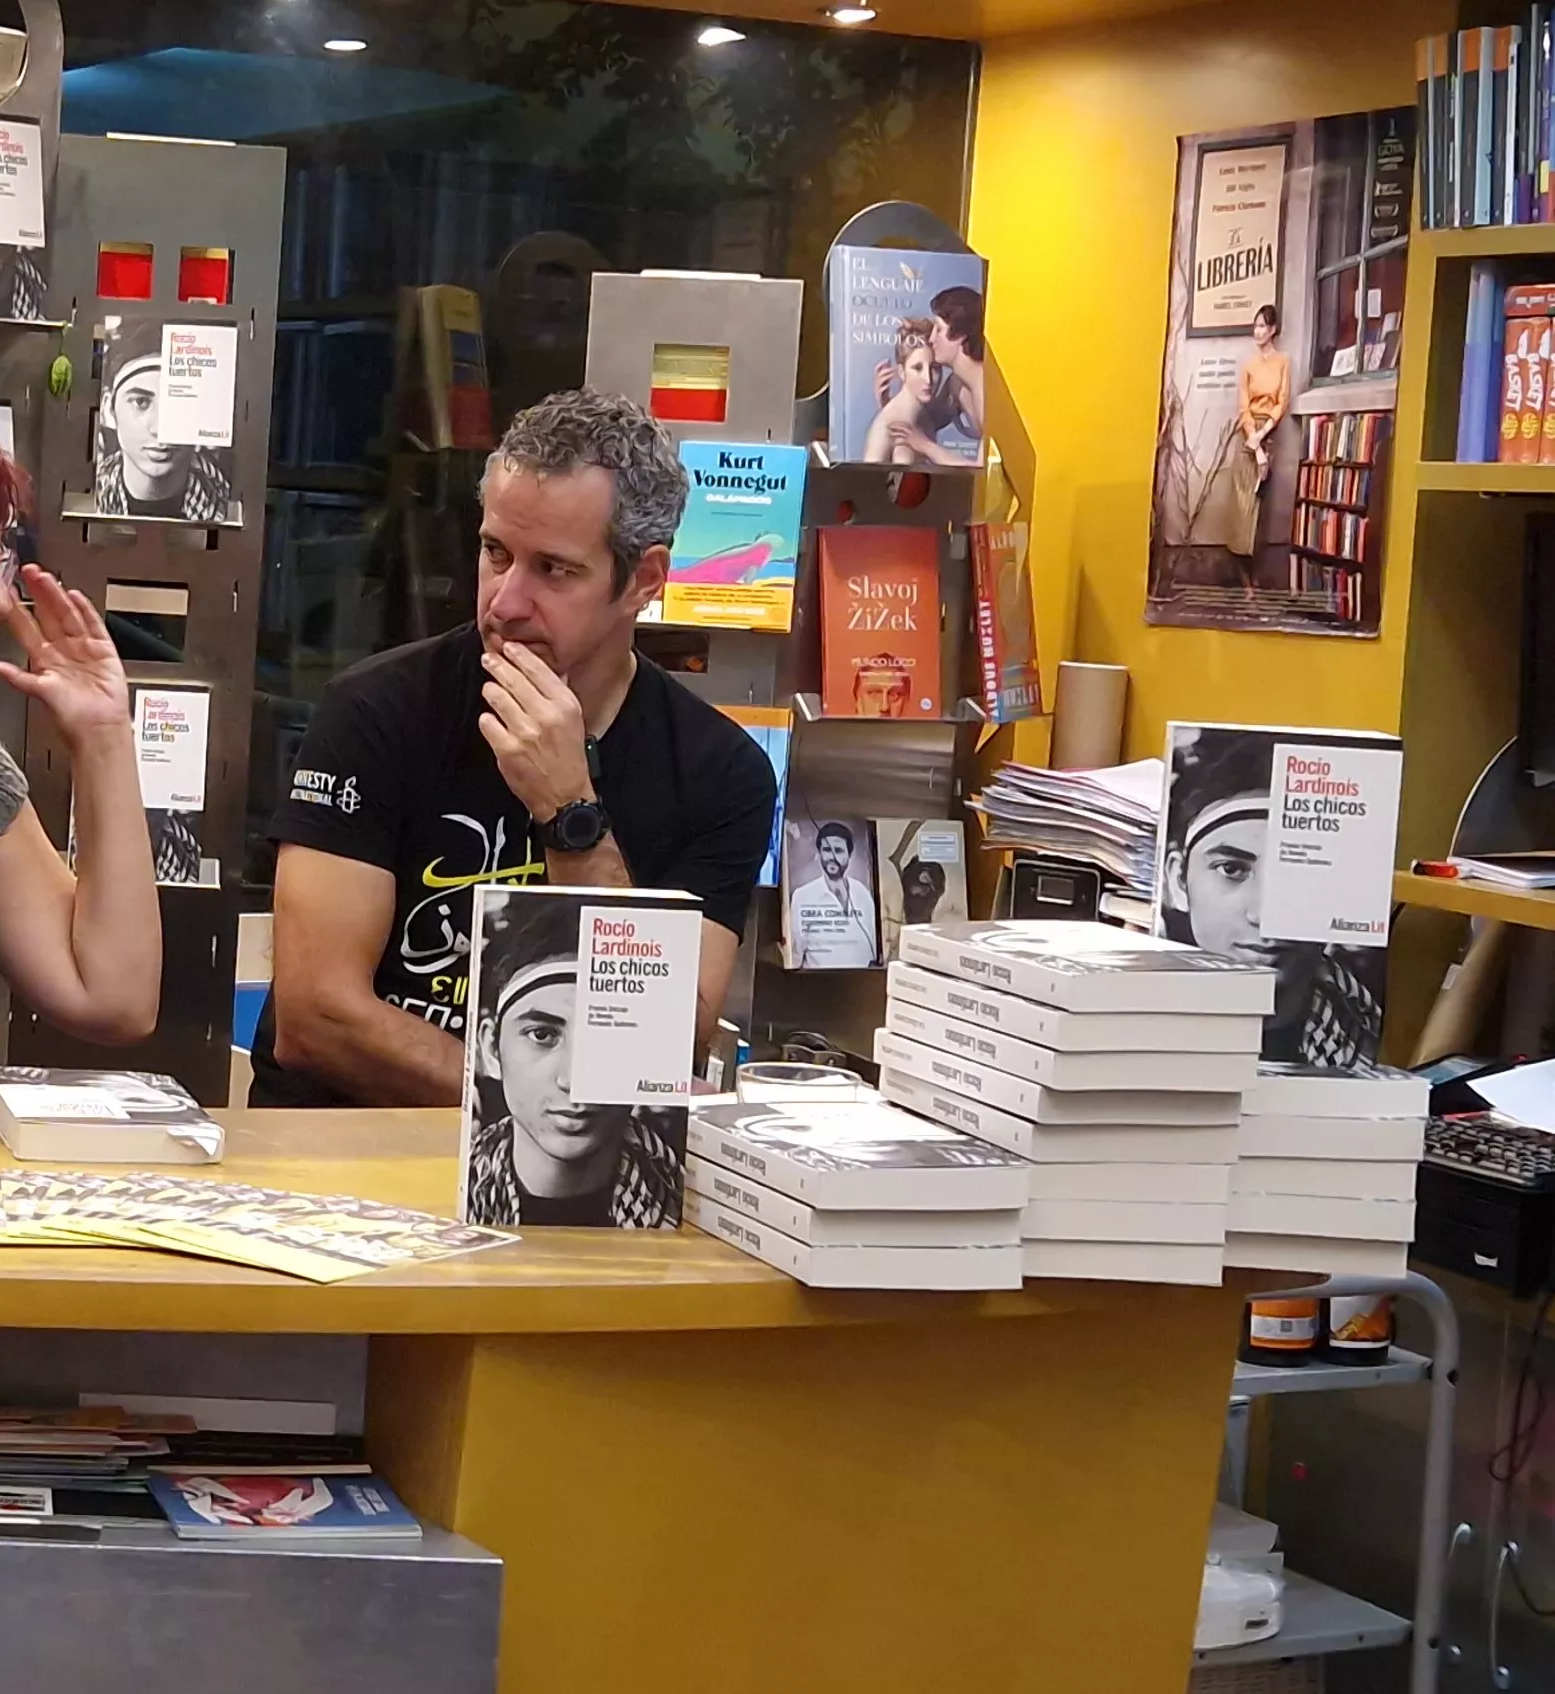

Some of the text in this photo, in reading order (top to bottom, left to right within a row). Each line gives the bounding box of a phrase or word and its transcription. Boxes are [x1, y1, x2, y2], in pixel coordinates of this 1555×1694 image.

[1197, 236, 1274, 292] LIBRERÍA
[719, 452, 764, 470] Kurt
[693, 470, 787, 493] Vonnegut
[848, 575, 919, 606] Slavoj
[1285, 775, 1360, 797] Lardinois
[1283, 794, 1366, 816] Los chicos
[1282, 813, 1340, 832] tuertos
[593, 918, 635, 937] Rocío
[1329, 917, 1370, 932] Alianza
[592, 938, 662, 957] Lardinois
[591, 957, 669, 977] Los chicos
[590, 976, 645, 994] tuertos
[636, 1079, 673, 1093] Alianza
